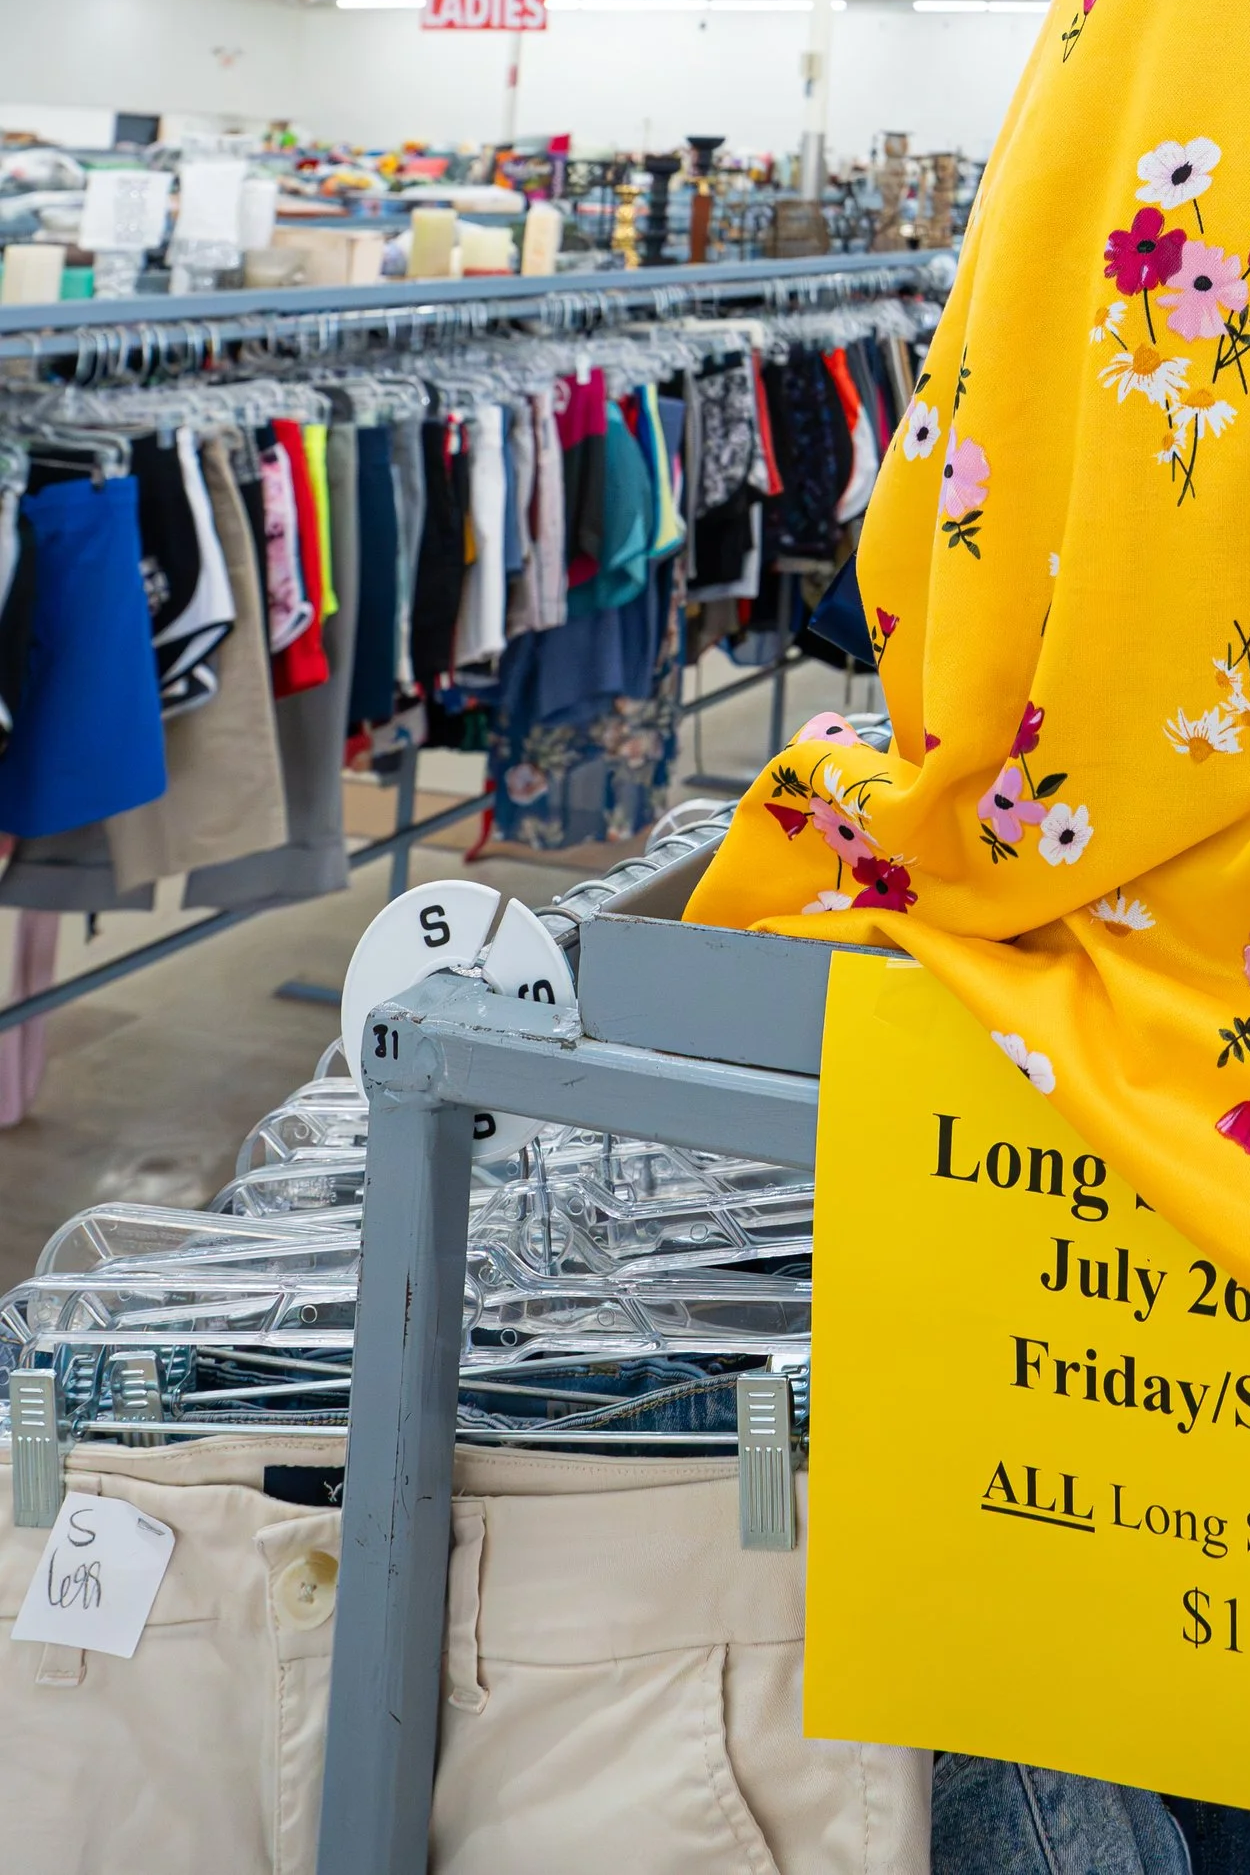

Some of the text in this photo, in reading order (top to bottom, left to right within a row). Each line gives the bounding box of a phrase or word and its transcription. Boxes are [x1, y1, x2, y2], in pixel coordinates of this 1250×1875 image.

[419, 904, 450, 948] S
[930, 1112, 1109, 1222] Long
[1040, 1236, 1168, 1322] July
[68, 1509, 96, 1547] S
[981, 1460, 1096, 1533] ALL
[1110, 1483, 1229, 1559] Long
